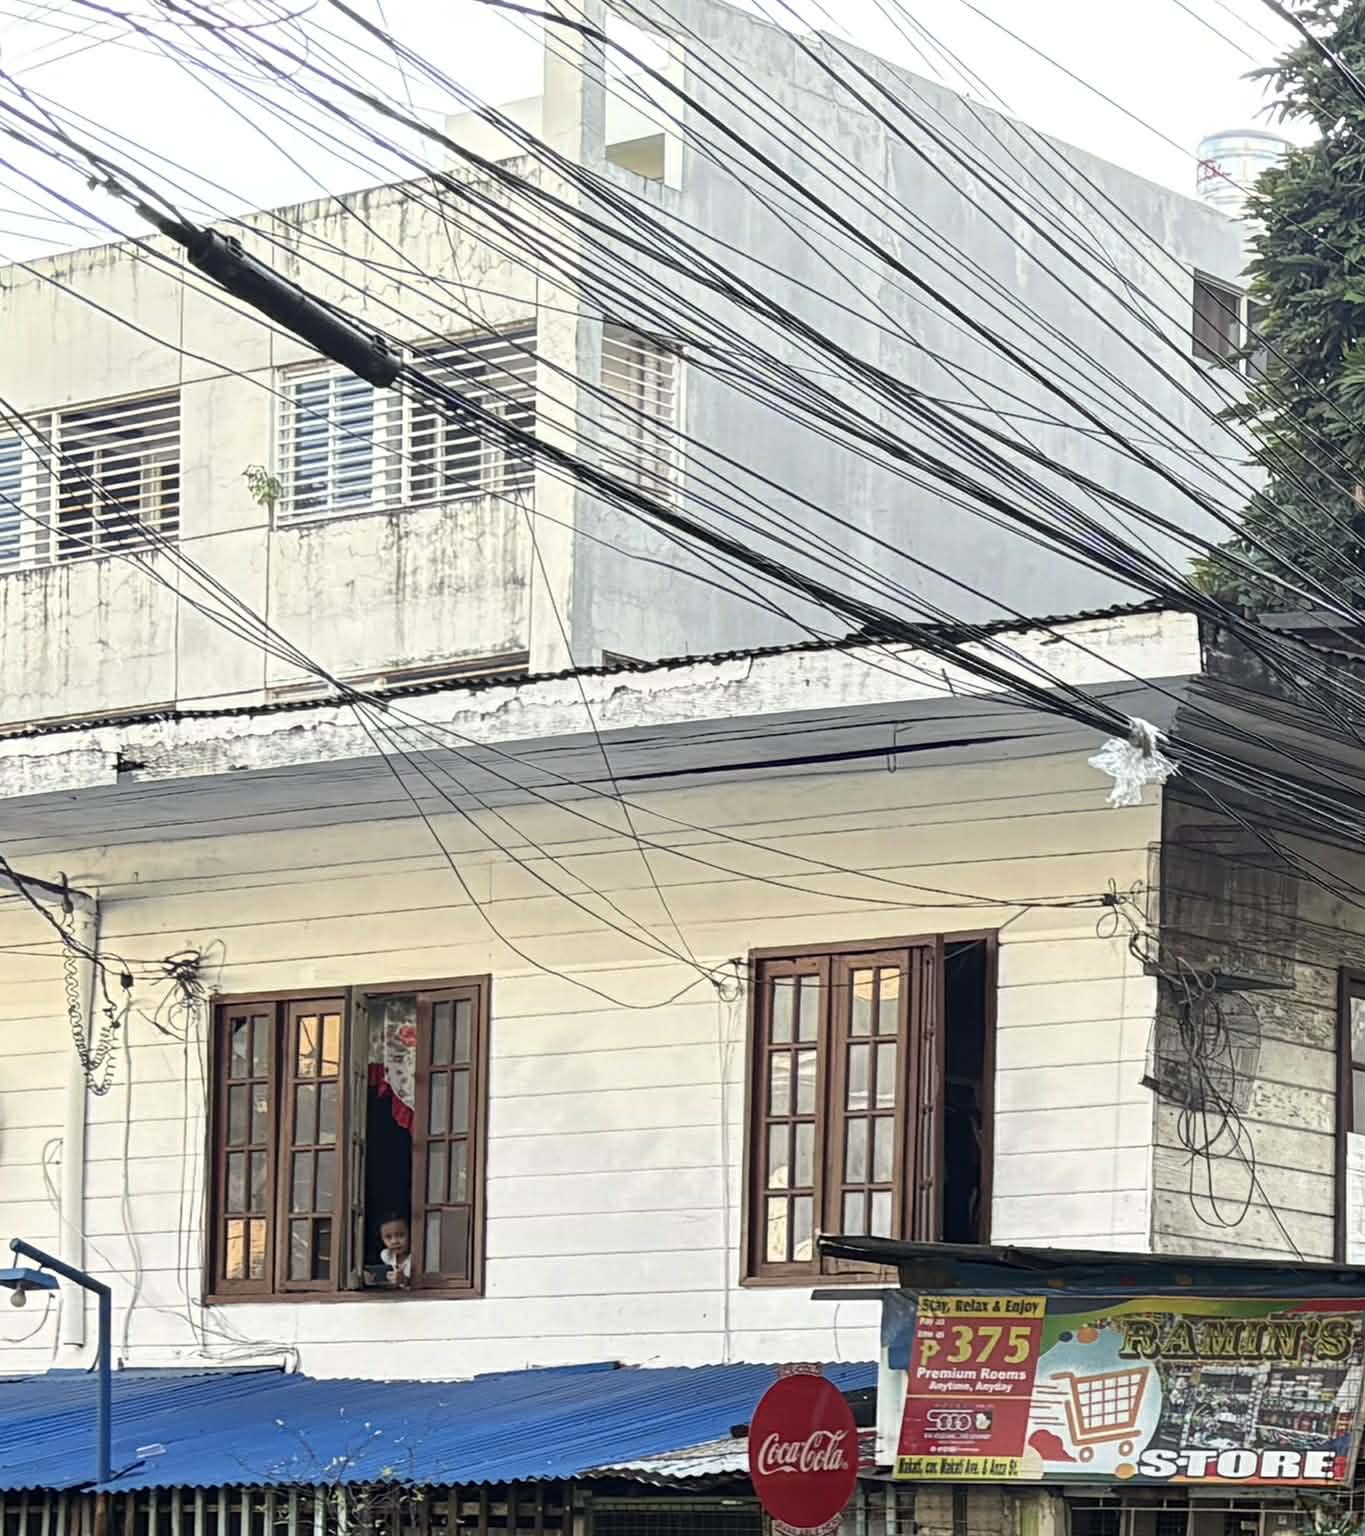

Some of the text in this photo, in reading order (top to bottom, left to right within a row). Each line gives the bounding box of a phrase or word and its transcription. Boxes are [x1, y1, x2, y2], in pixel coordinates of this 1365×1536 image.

[955, 1300, 988, 1313] Relax
[992, 1301, 1001, 1312] &
[1005, 1301, 1039, 1315] Enjoy
[946, 1325, 1033, 1365] 375
[1119, 1318, 1354, 1361] RAMIN'S
[916, 1367, 1027, 1380] Premium Rooms
[1140, 1449, 1337, 1479] STORE
